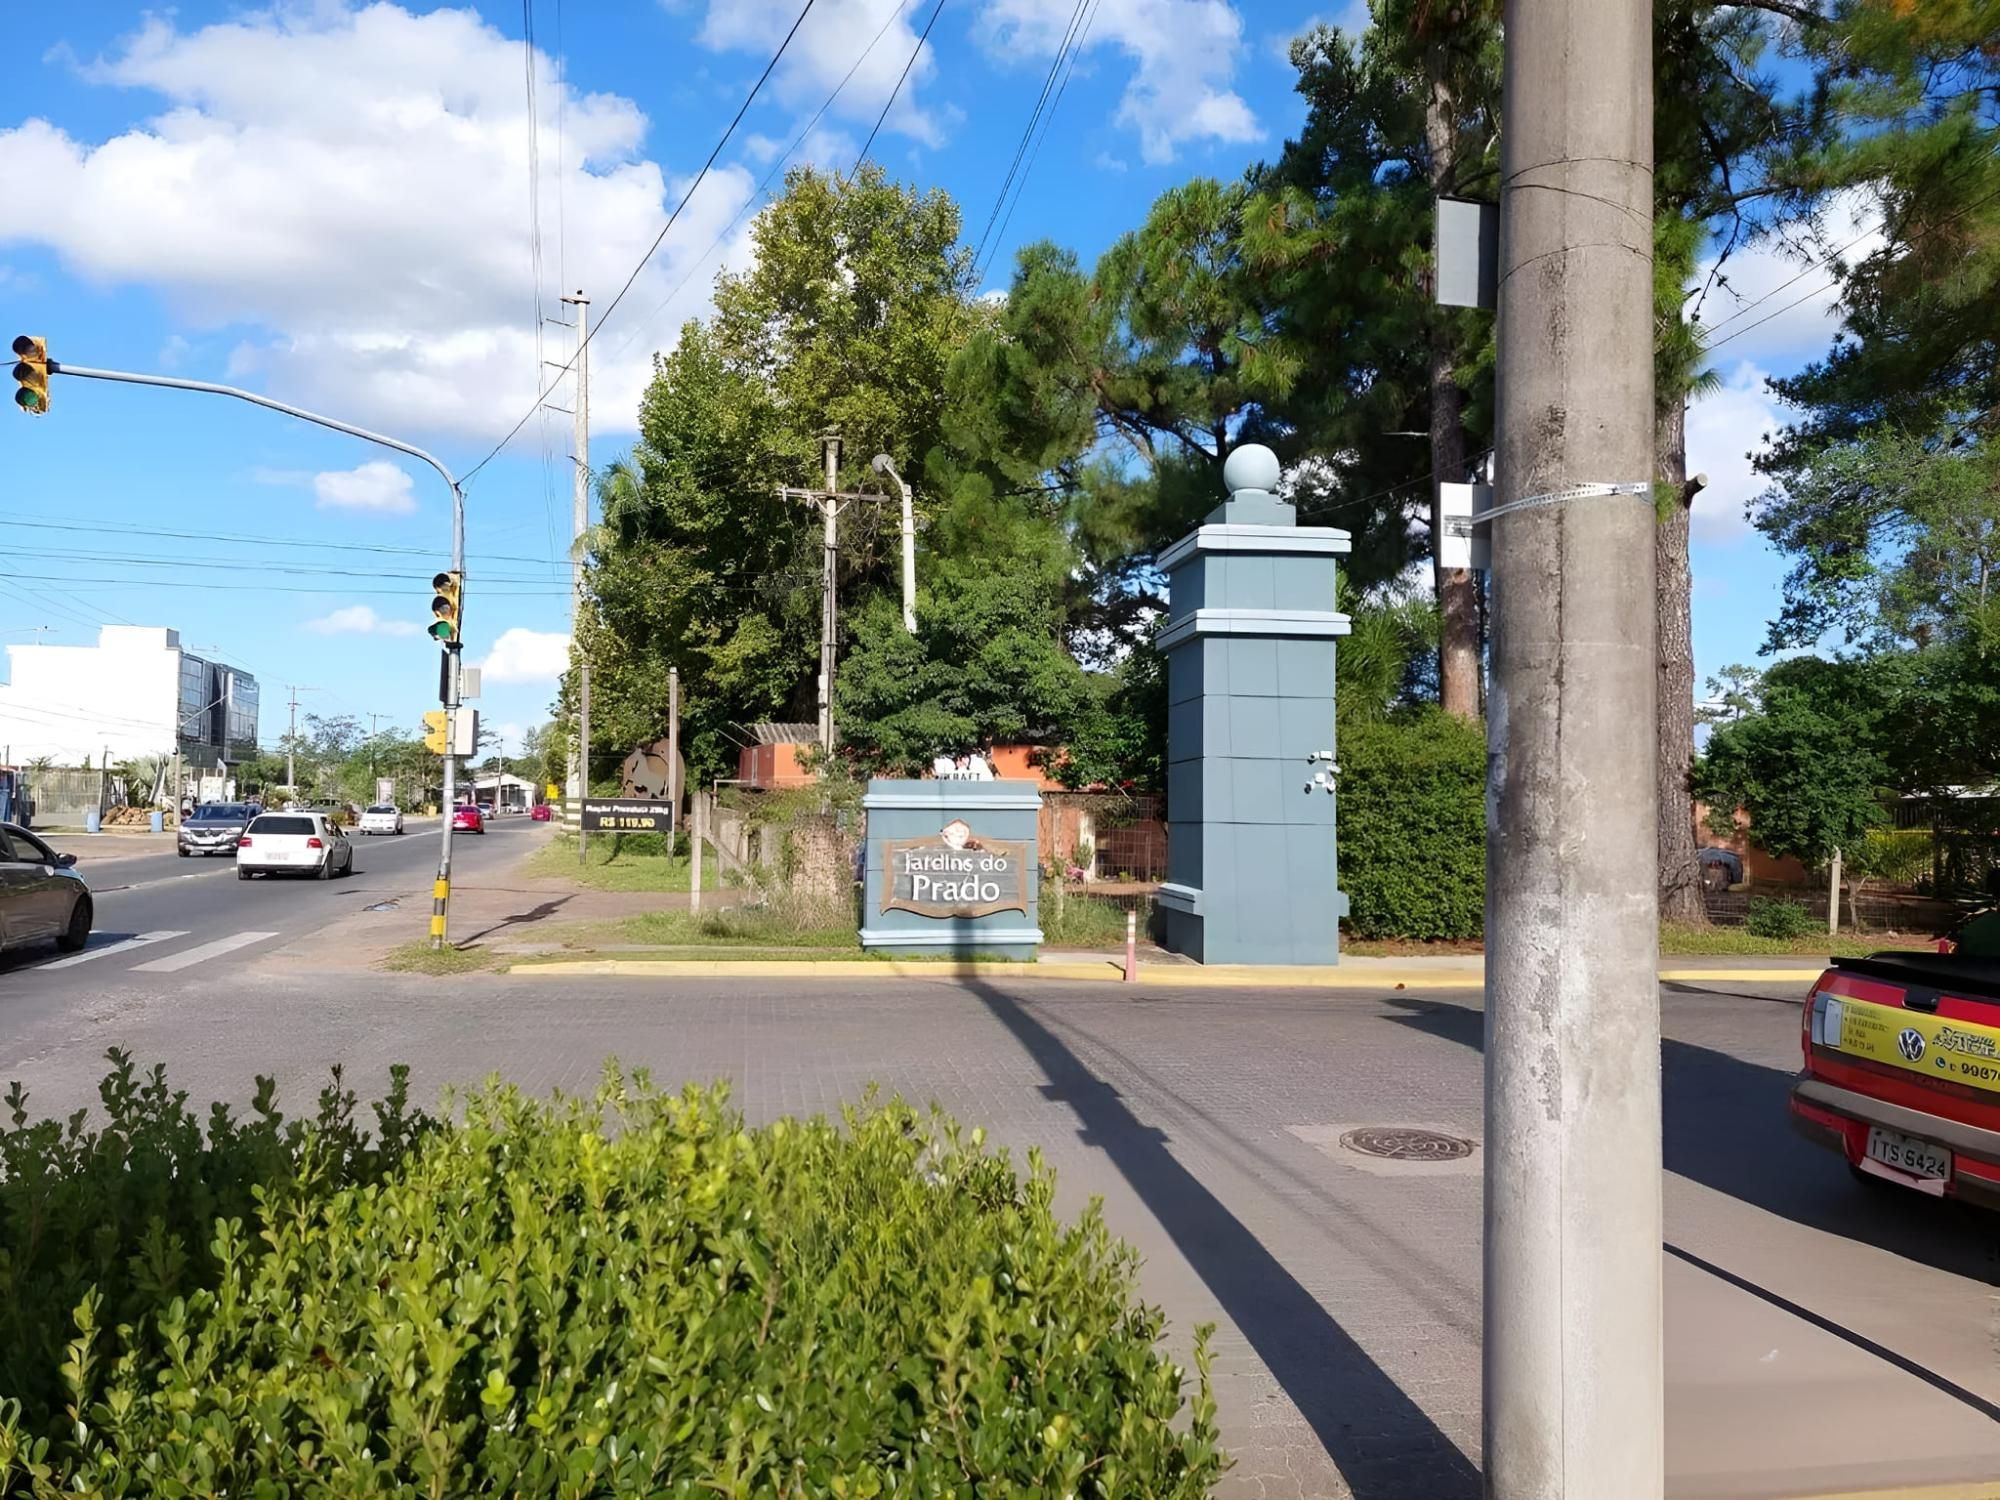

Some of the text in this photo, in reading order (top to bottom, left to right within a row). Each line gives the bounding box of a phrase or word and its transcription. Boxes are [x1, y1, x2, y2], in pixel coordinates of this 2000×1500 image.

[905, 853, 1008, 873] Jardins do
[912, 874, 1000, 902] Prado
